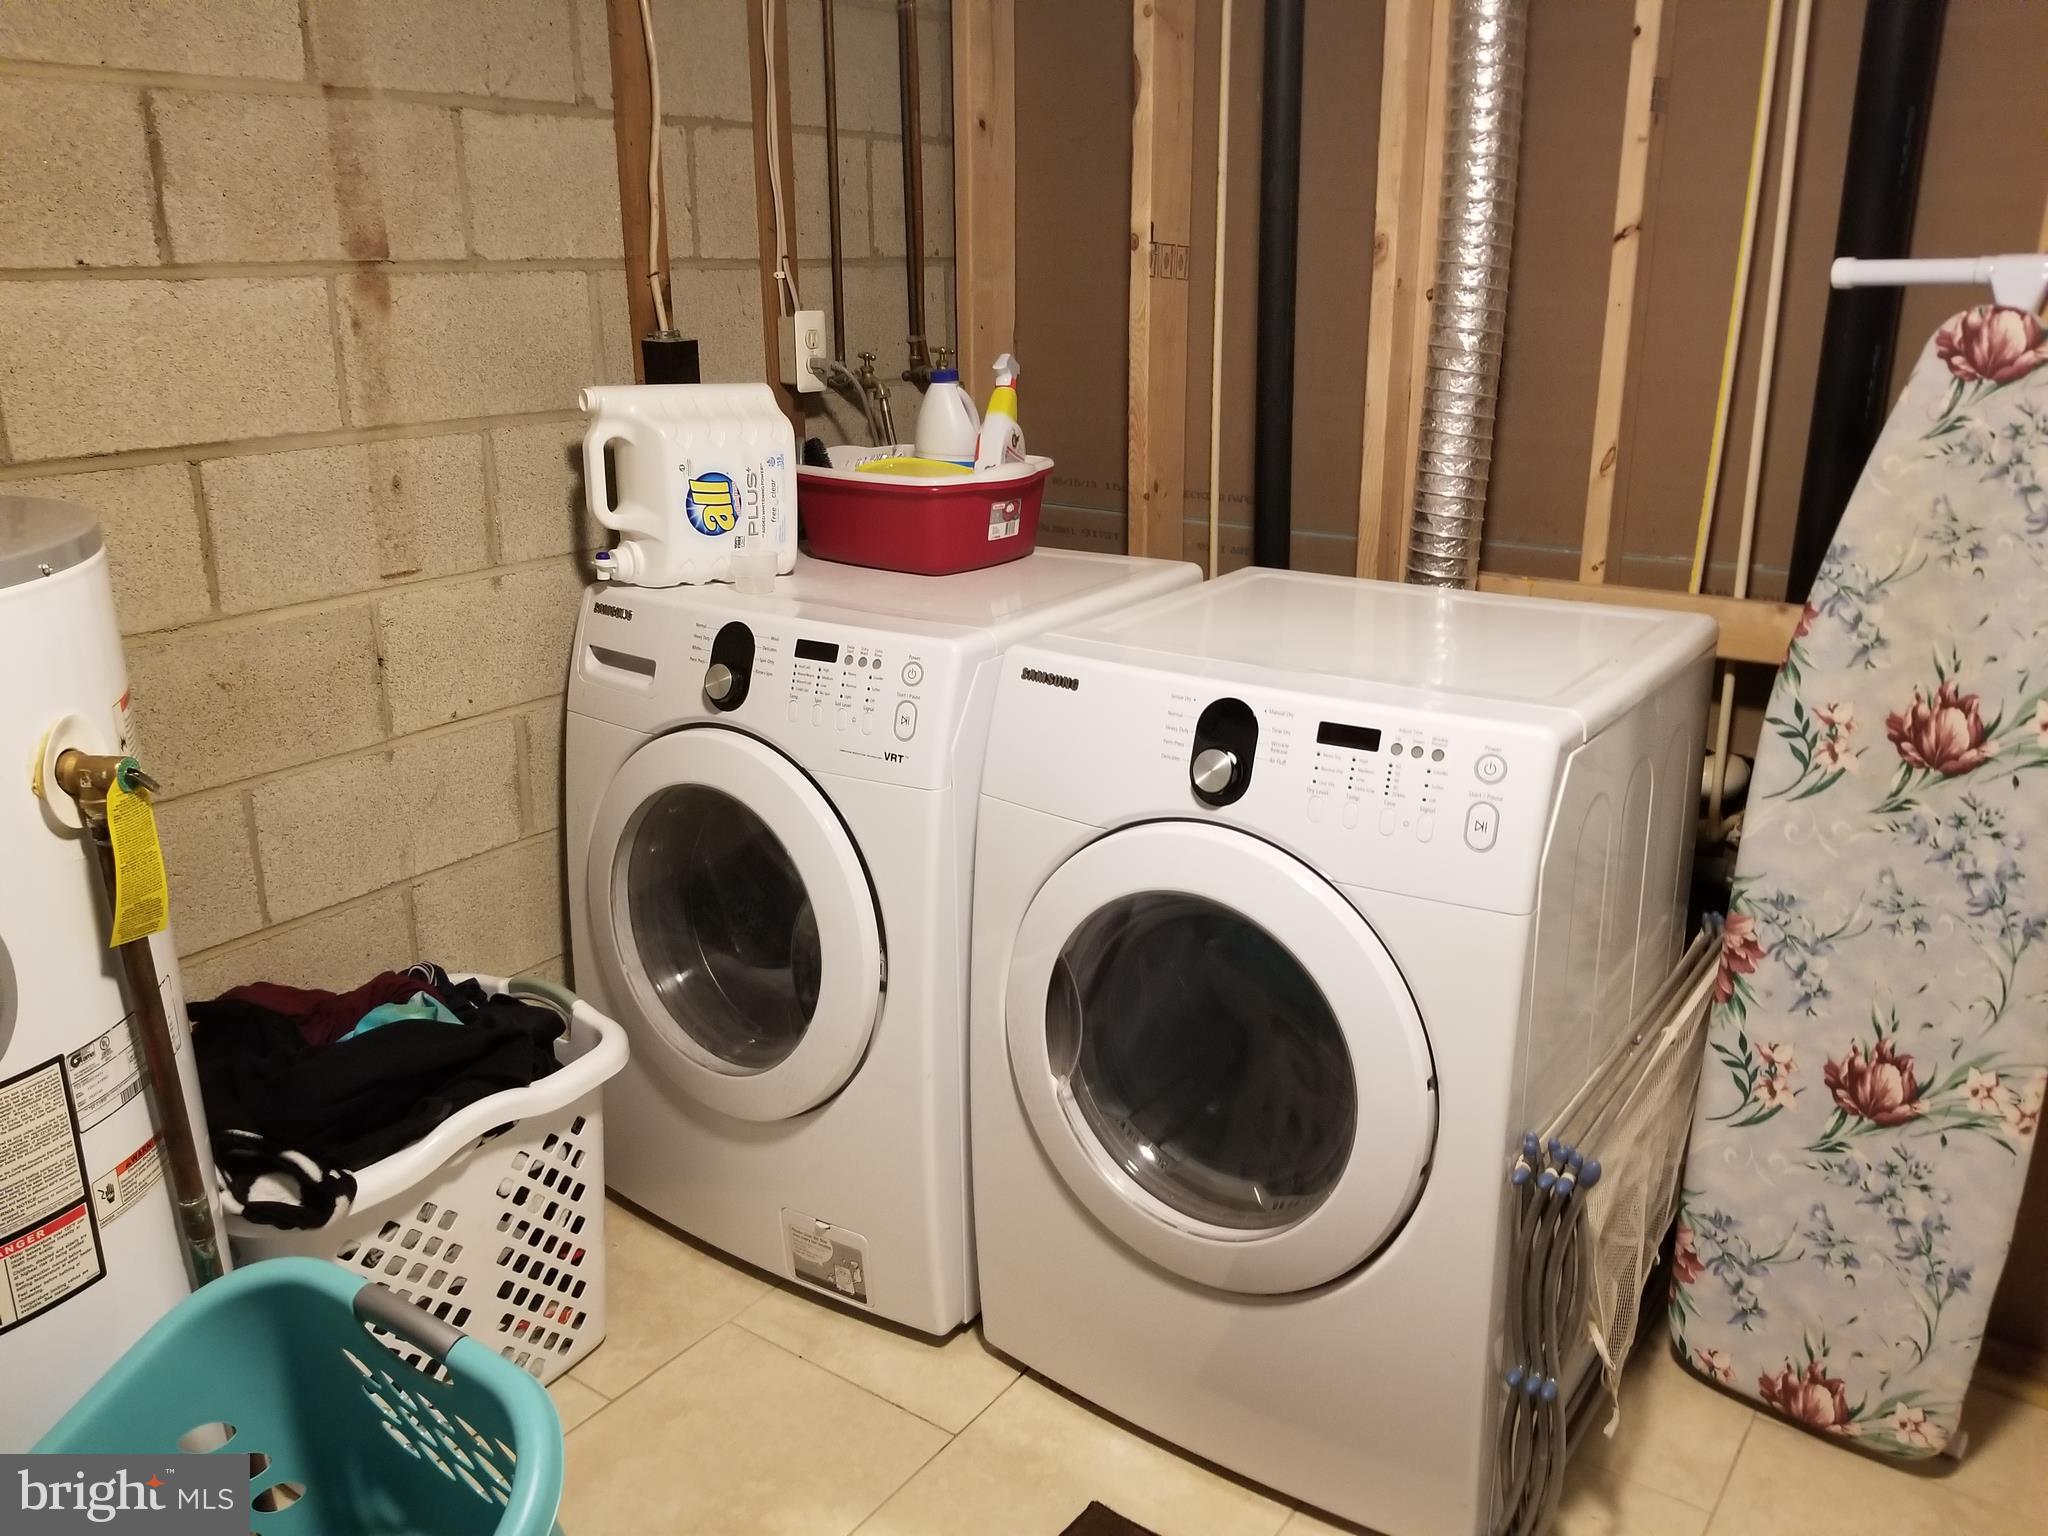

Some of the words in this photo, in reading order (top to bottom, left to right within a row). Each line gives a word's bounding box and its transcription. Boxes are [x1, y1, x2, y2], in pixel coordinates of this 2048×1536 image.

[688, 478, 736, 531] all
[1021, 667, 1080, 692] SAMSUNG
[884, 751, 905, 764] VRT
